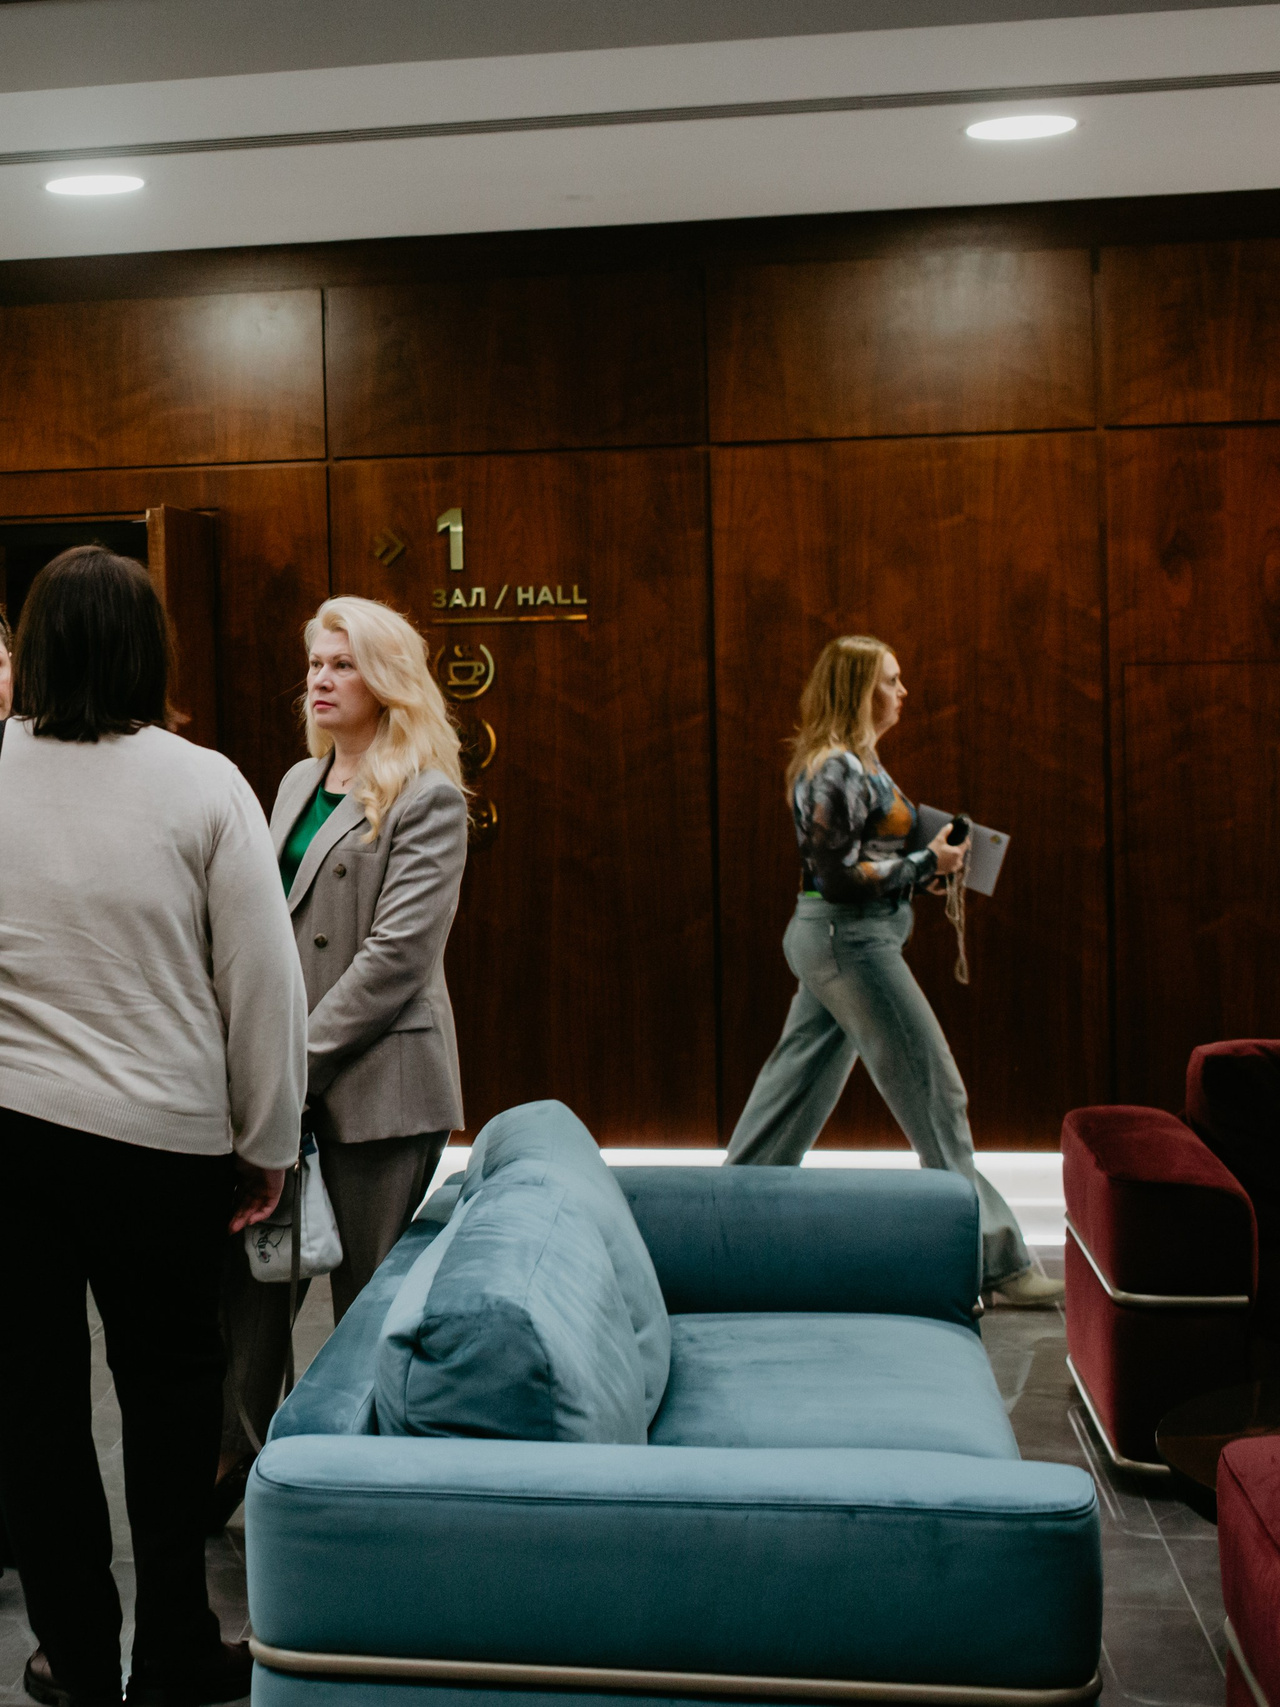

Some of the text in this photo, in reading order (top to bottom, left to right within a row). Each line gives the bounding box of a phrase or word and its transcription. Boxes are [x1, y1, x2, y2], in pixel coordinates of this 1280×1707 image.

[436, 507, 464, 571] 1
[432, 587, 485, 609] ЗАЛ
[517, 584, 587, 606] HALL
